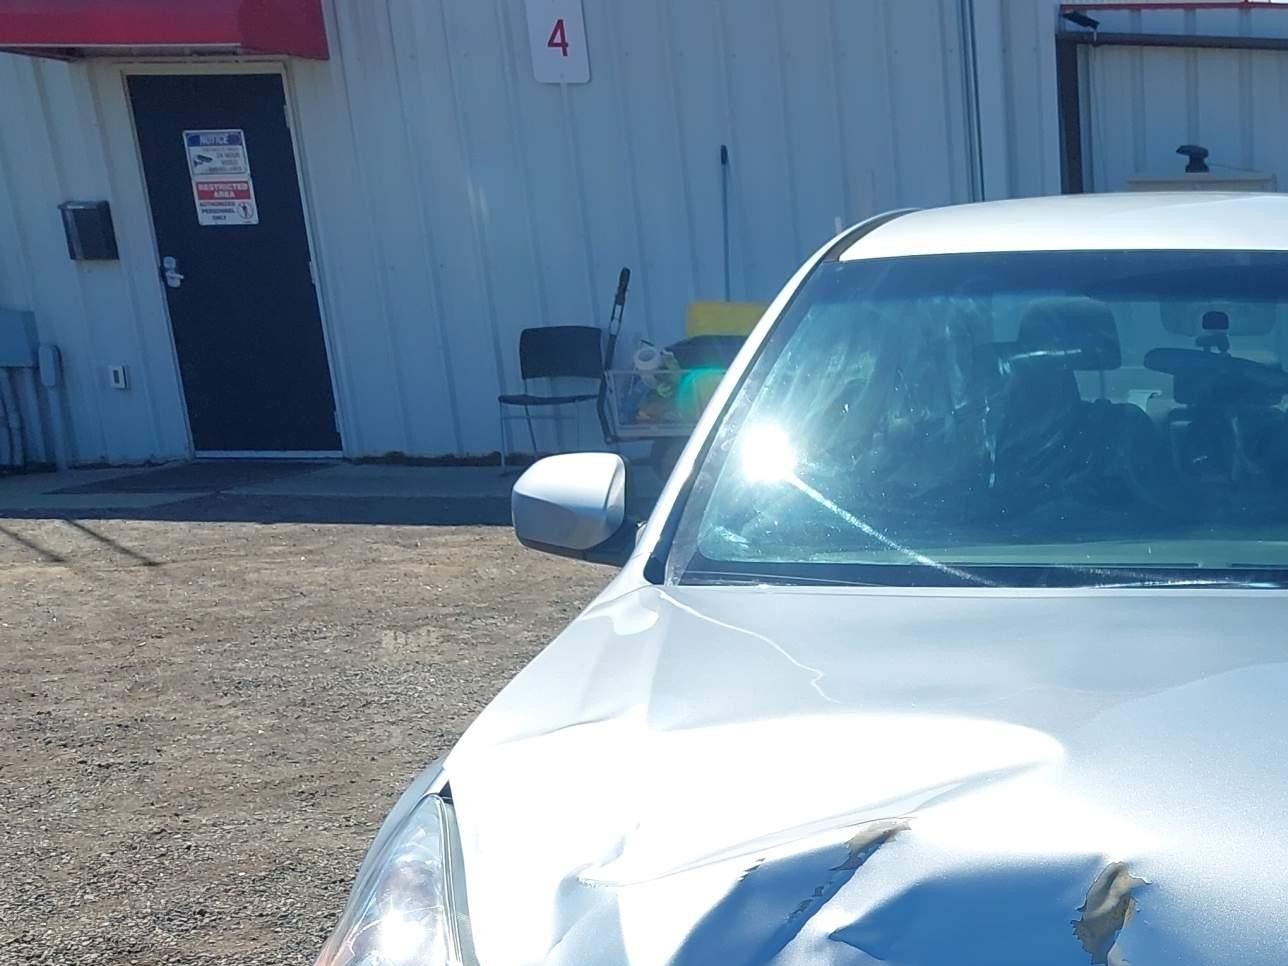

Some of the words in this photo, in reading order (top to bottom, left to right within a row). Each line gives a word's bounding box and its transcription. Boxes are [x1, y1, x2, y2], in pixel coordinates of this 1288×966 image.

[547, 19, 569, 57] 4
[200, 134, 229, 145] NOTICE
[198, 183, 248, 191] RESTRICTED
